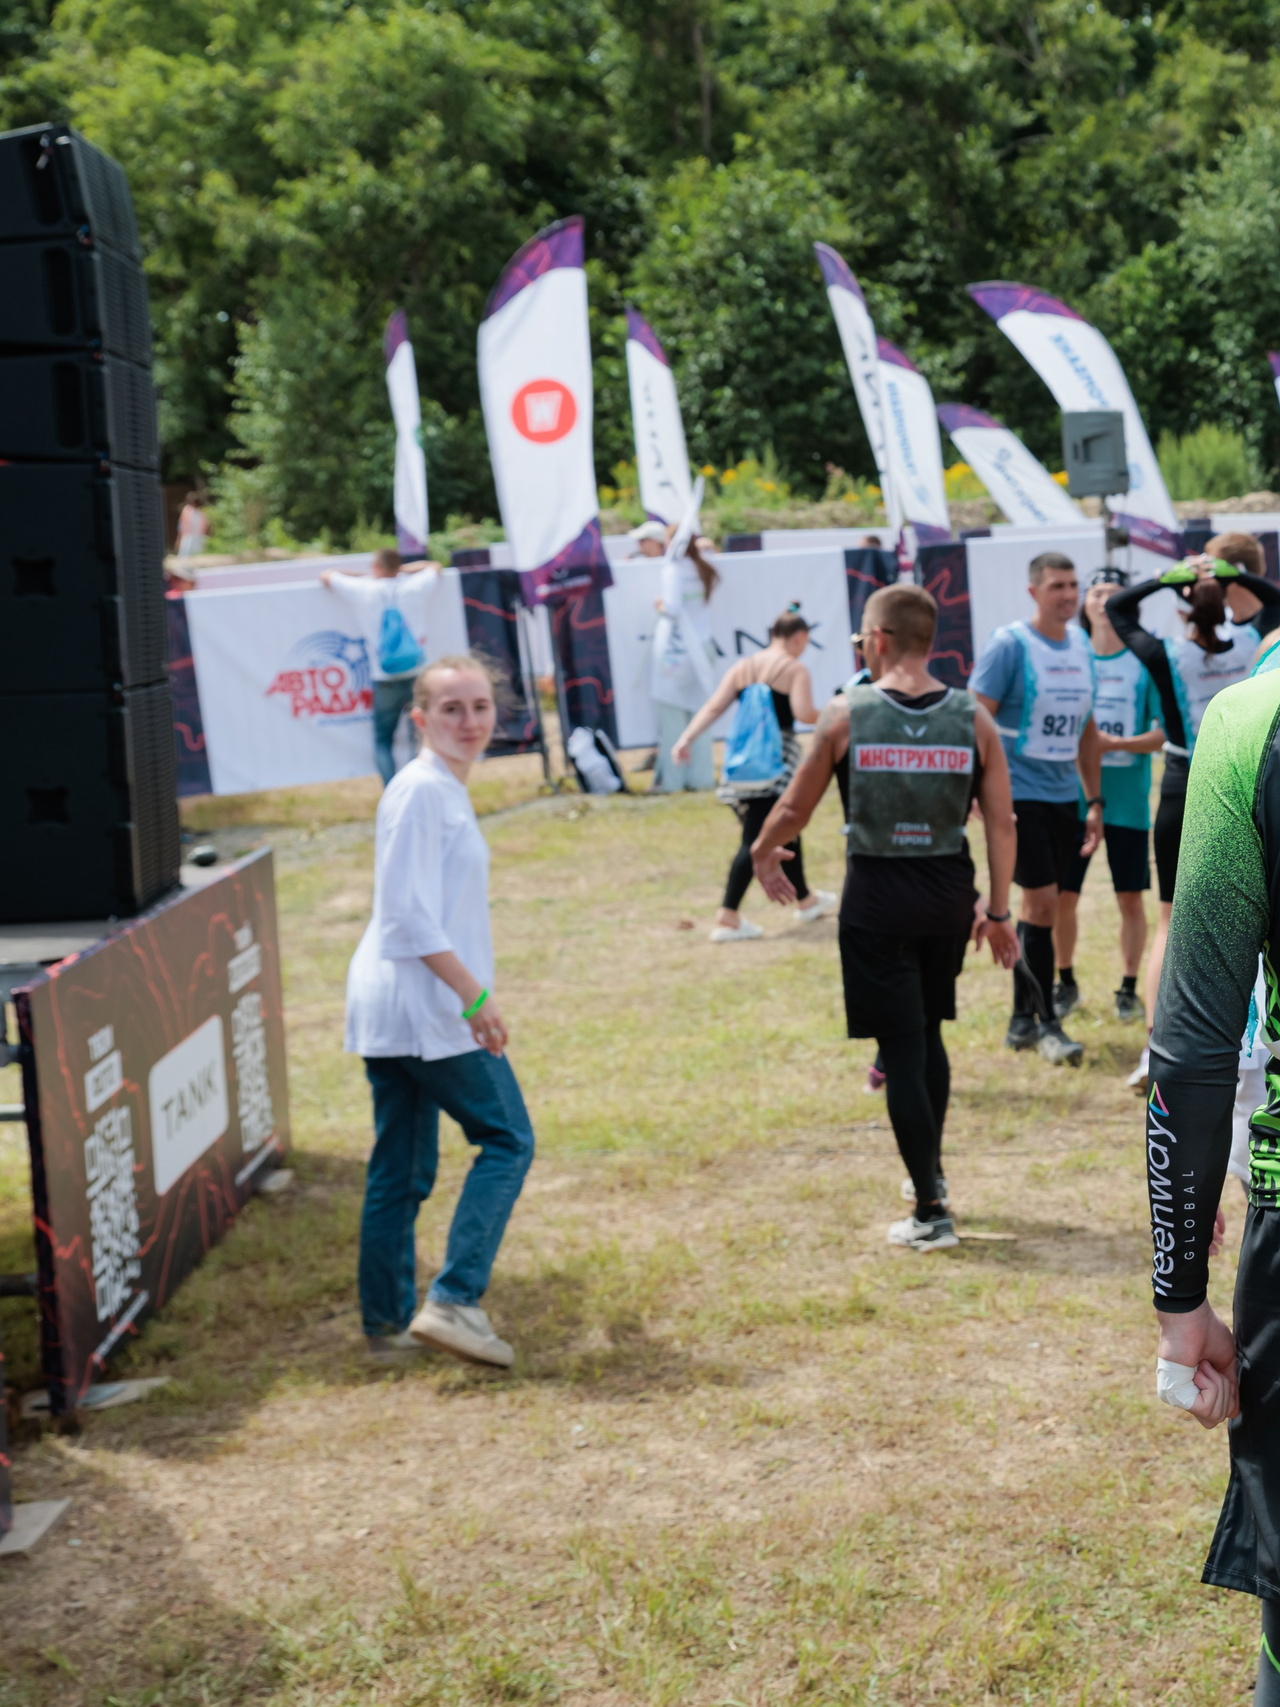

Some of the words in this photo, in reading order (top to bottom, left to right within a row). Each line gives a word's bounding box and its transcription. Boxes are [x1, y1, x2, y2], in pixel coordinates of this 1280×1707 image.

[265, 666, 346, 696] АВТО
[858, 748, 970, 770] ИНСТРУКТОР
[160, 1058, 217, 1141] TANK
[1148, 1110, 1177, 1297] reenway
[1182, 1170, 1196, 1261] GLOBAL
